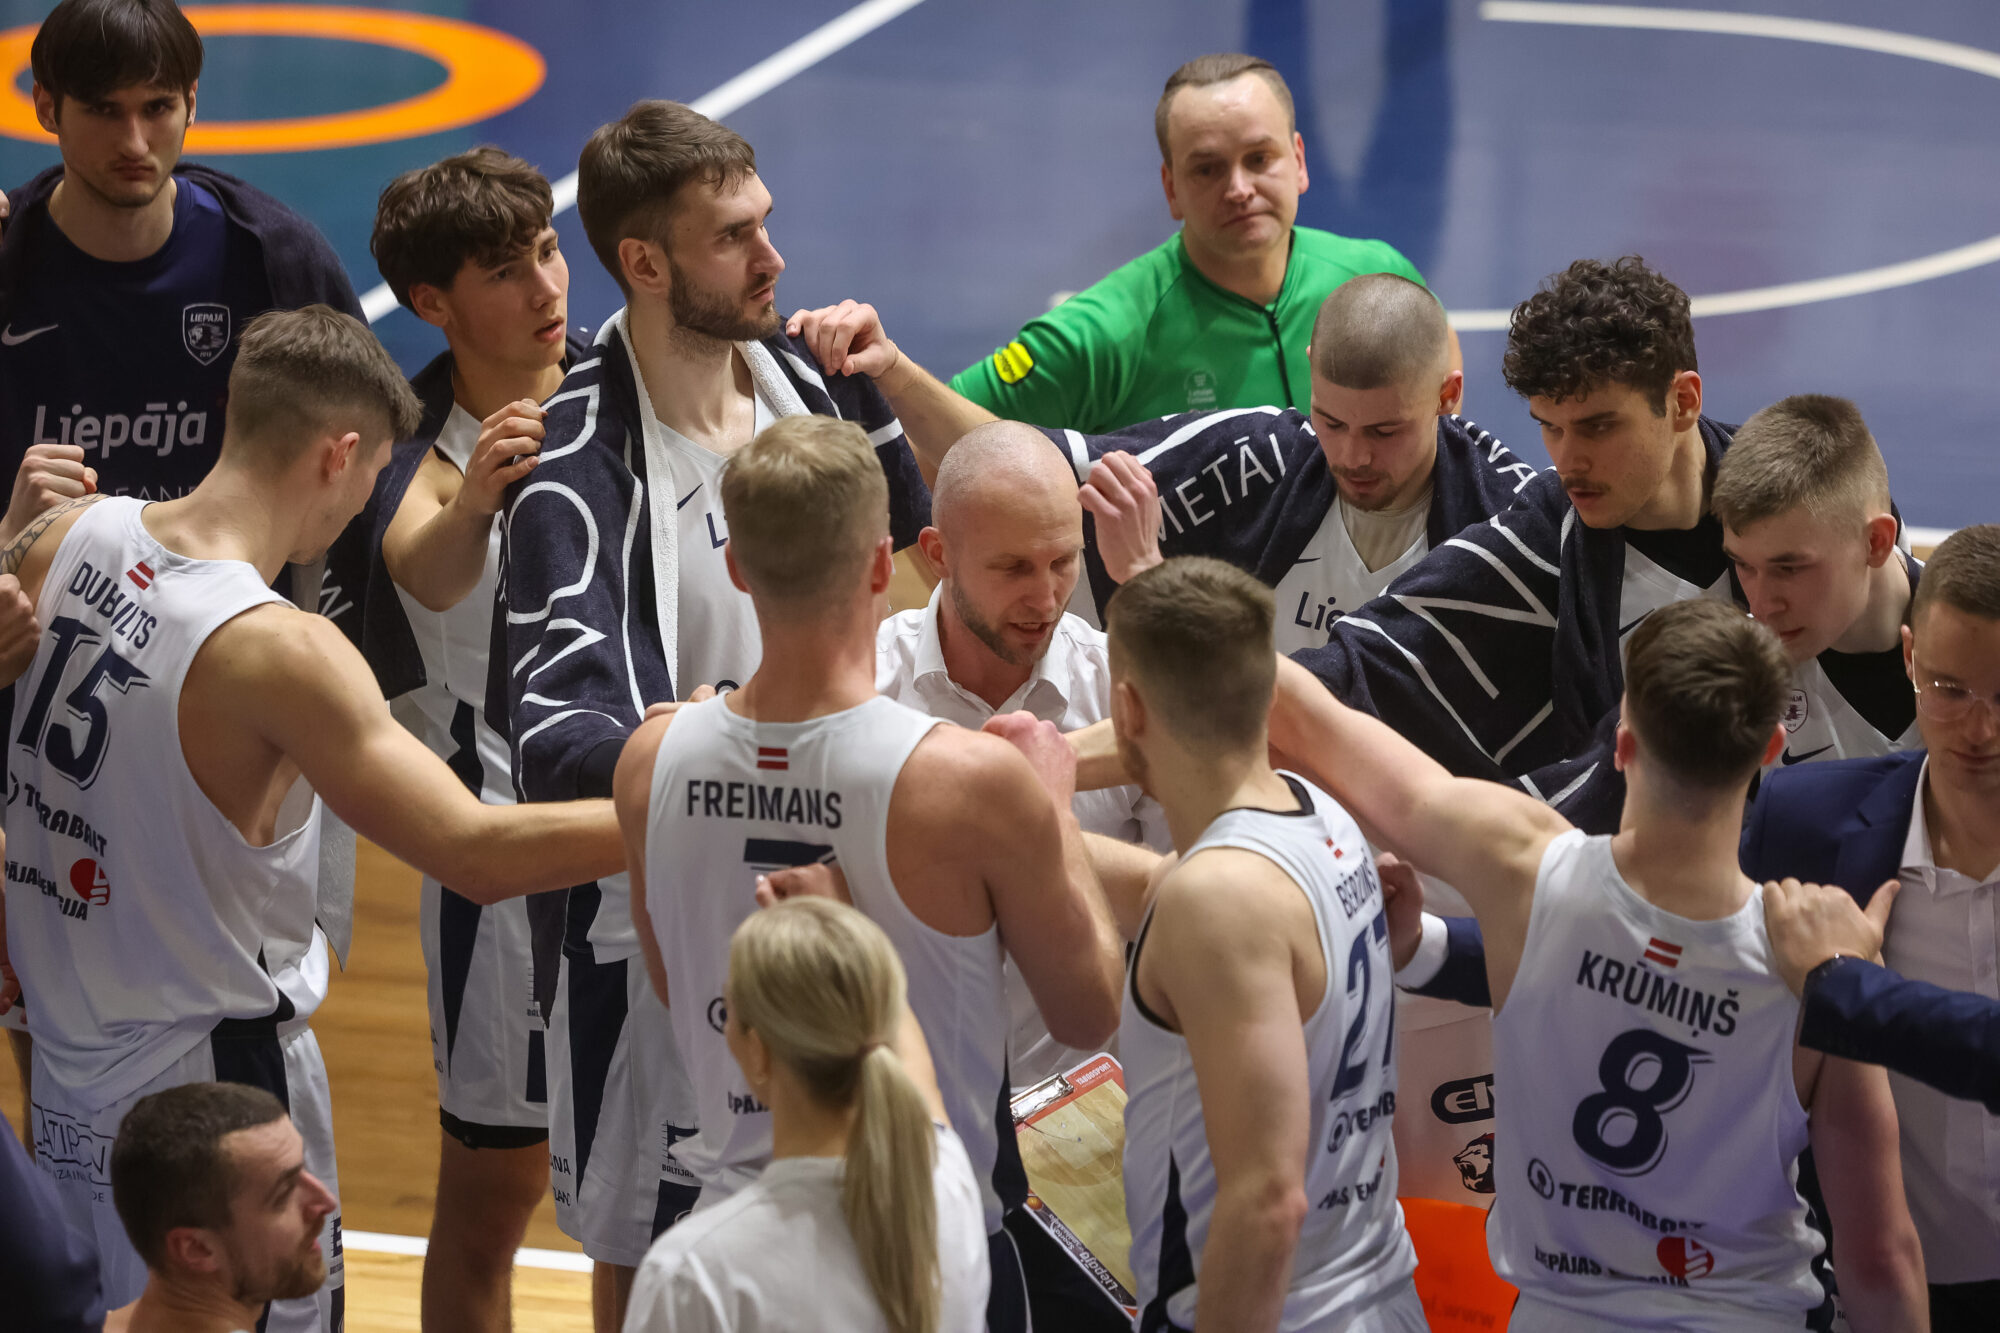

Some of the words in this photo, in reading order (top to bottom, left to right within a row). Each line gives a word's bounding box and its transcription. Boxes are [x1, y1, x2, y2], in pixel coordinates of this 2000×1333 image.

[34, 401, 207, 459] Liepāja
[16, 615, 151, 791] 15
[687, 779, 842, 829] FREIMANS
[1576, 950, 1740, 1038] KRŪMIŅŠ
[1572, 1028, 1716, 1177] 8
